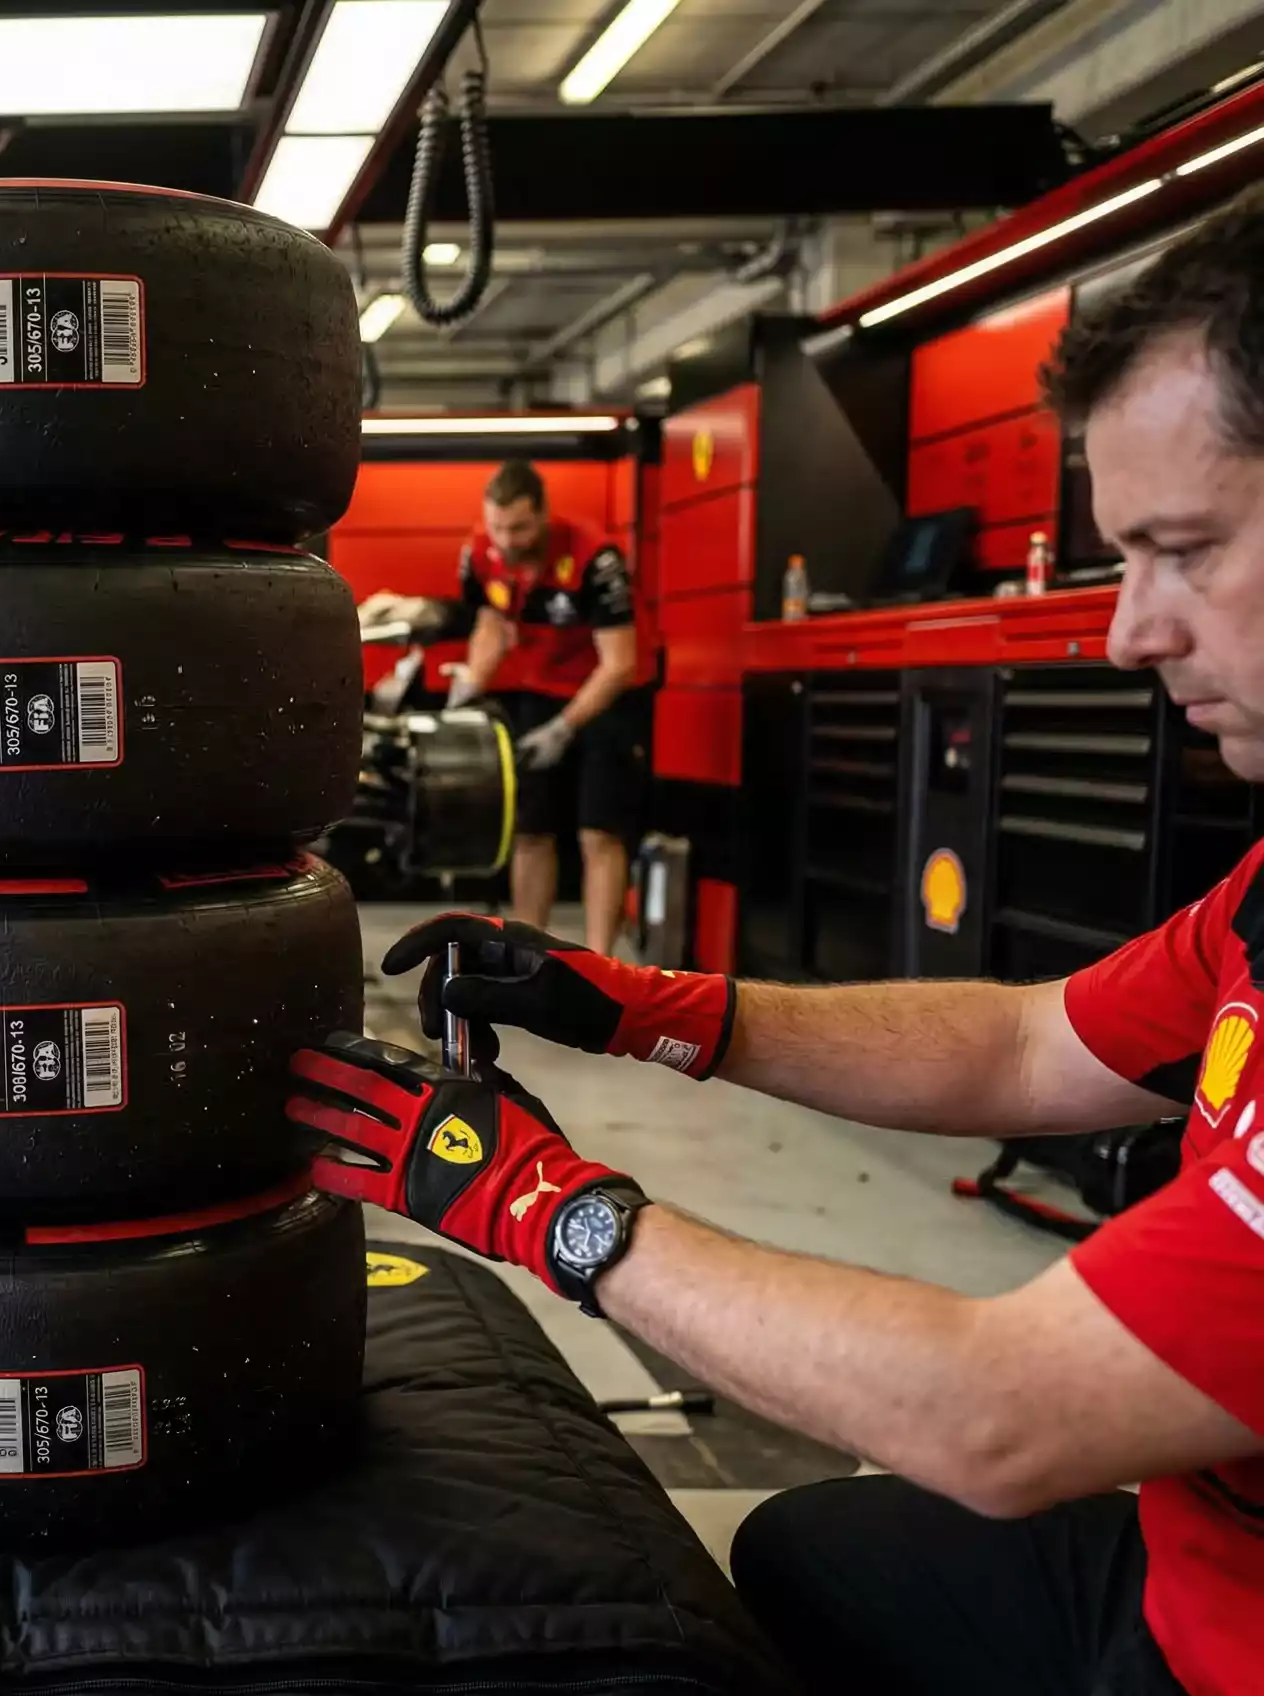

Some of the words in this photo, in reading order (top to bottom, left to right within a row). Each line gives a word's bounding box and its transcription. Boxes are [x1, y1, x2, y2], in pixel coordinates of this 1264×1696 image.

[25, 287, 44, 374] 305/670-13
[3, 673, 21, 756] 305/670-13
[33, 1386, 52, 1464] 305/670-13
